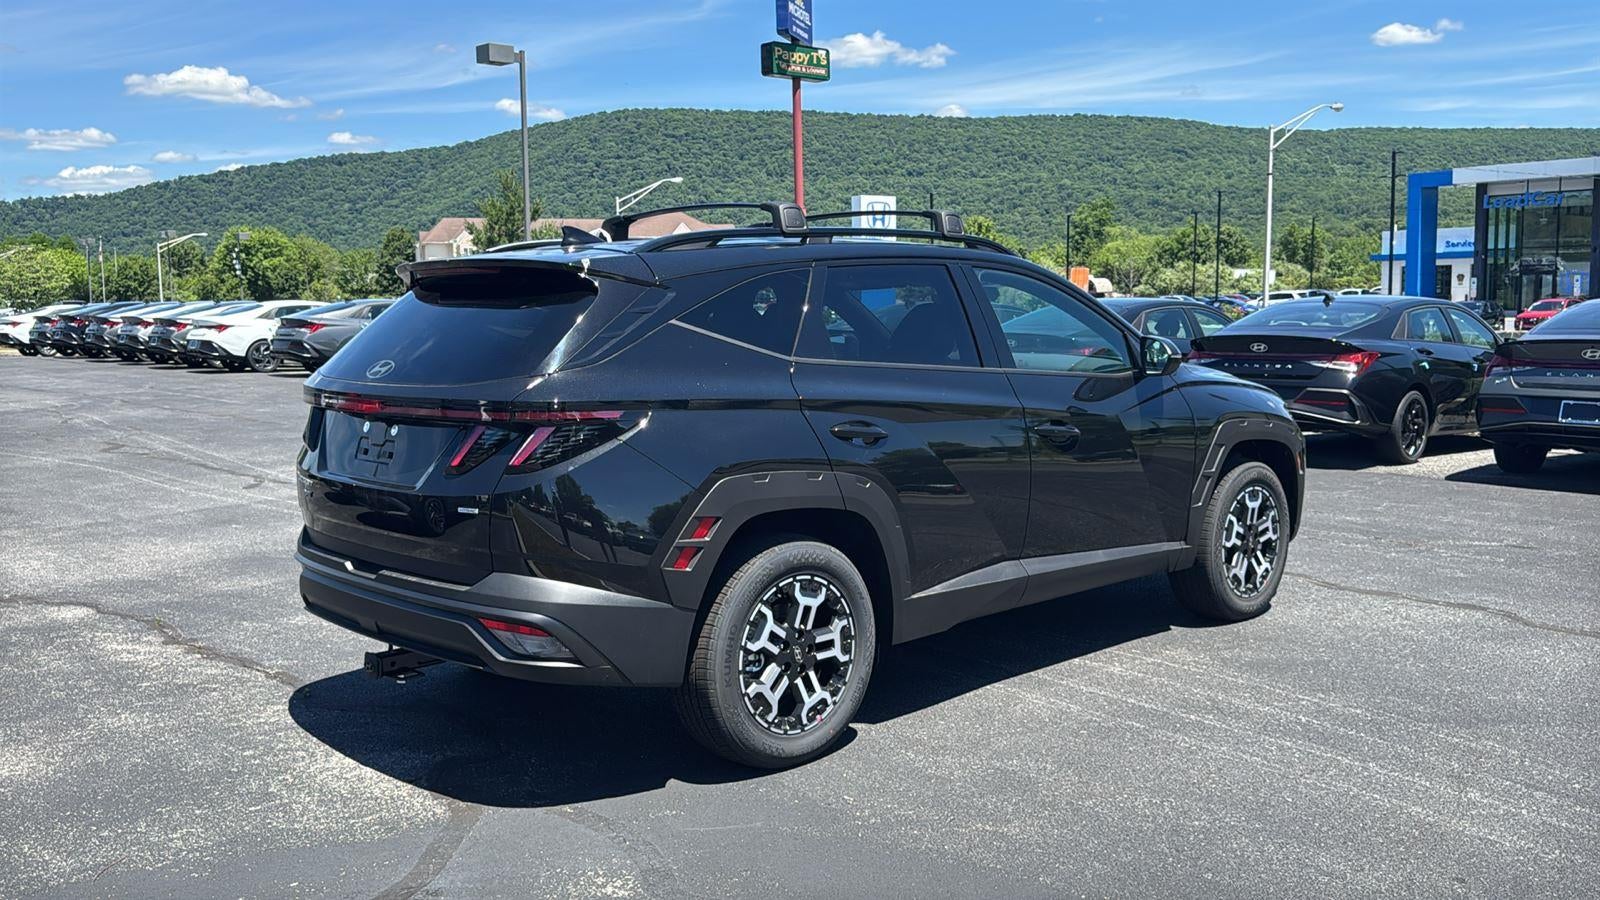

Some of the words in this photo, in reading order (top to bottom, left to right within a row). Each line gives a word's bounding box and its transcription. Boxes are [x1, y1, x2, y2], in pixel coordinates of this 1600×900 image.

[774, 46, 810, 65] Pappy
[811, 51, 828, 66] T's
[1483, 190, 1566, 209] LeadCar
